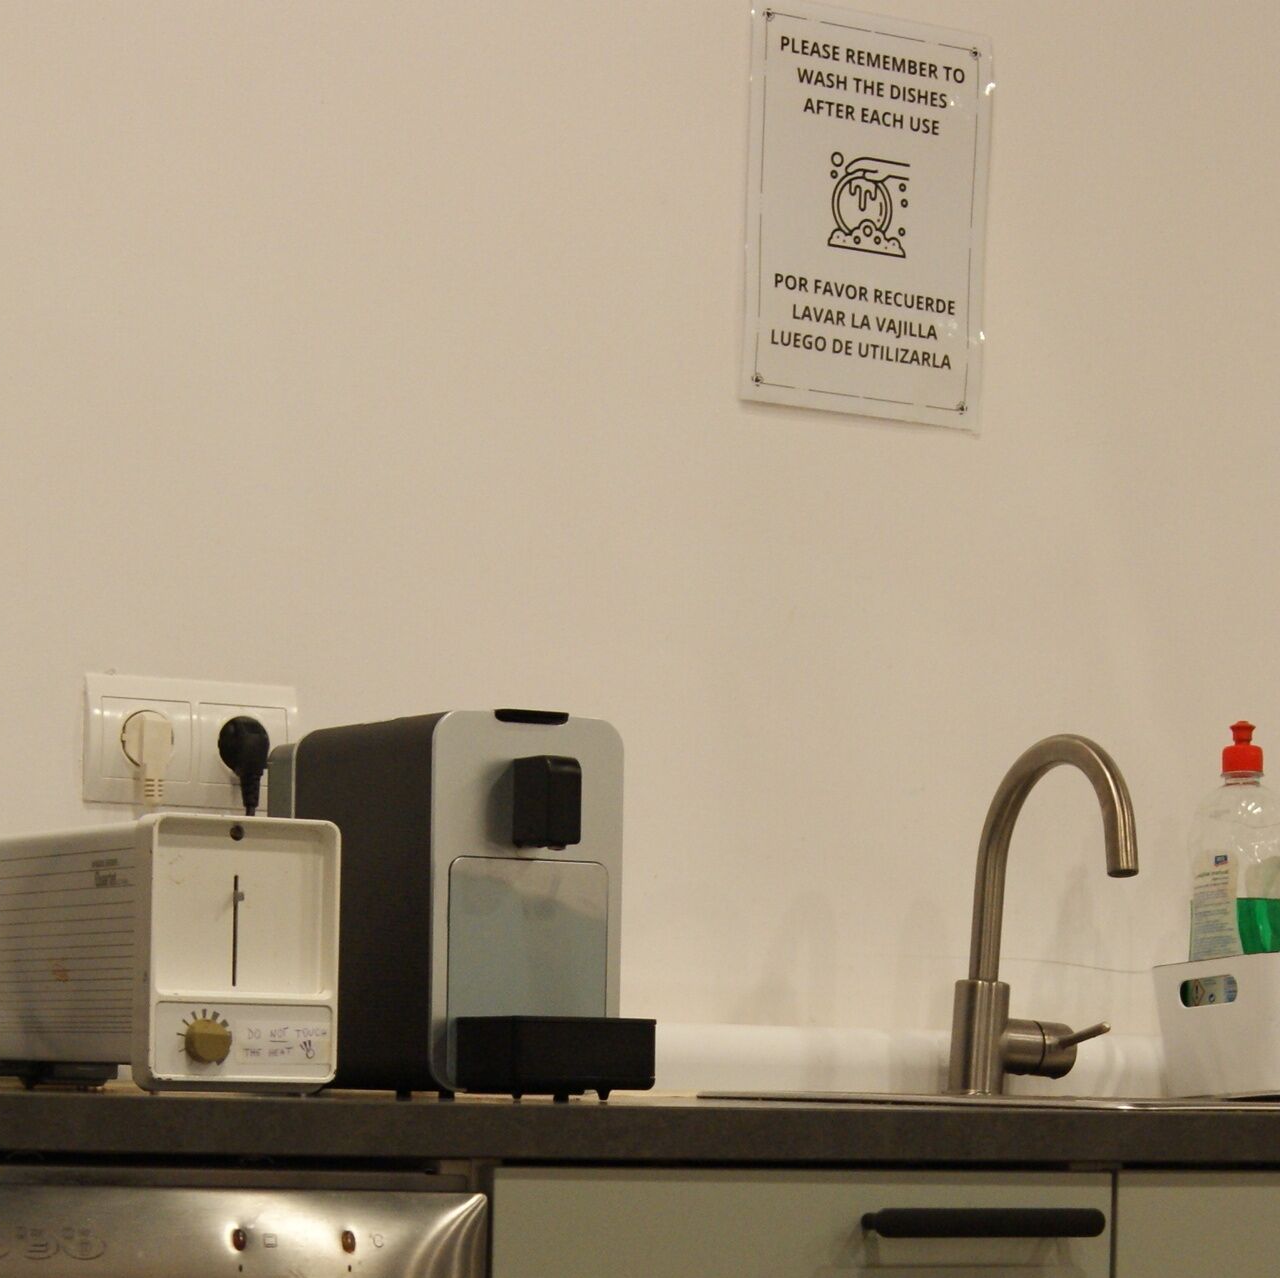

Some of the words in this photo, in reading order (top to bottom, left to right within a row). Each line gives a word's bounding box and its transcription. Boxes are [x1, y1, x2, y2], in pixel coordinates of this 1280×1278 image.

[780, 35, 840, 62] PLEASE
[846, 48, 938, 80] REMEMBER
[943, 65, 966, 84] TO
[797, 67, 848, 91] WASH
[853, 78, 884, 98] THE
[890, 83, 948, 109] DISHES
[803, 98, 856, 122] AFTER
[861, 108, 904, 130] EACH
[909, 116, 940, 136] USE
[774, 273, 809, 292] POR
[814, 280, 868, 302] FAVOR
[873, 288, 955, 315] RECUERDE
[792, 304, 846, 326] LAVAR
[851, 313, 871, 331] LA
[876, 317, 938, 341] VAJILLA
[770, 329, 827, 352] LUEGO
[832, 338, 852, 356] DE
[858, 342, 952, 370] UTILIZARLA
[242, 1048, 262, 1057] THE
[268, 1046, 294, 1057] HEAT
[247, 1027, 262, 1040] DO
[270, 1027, 289, 1038] NOT
